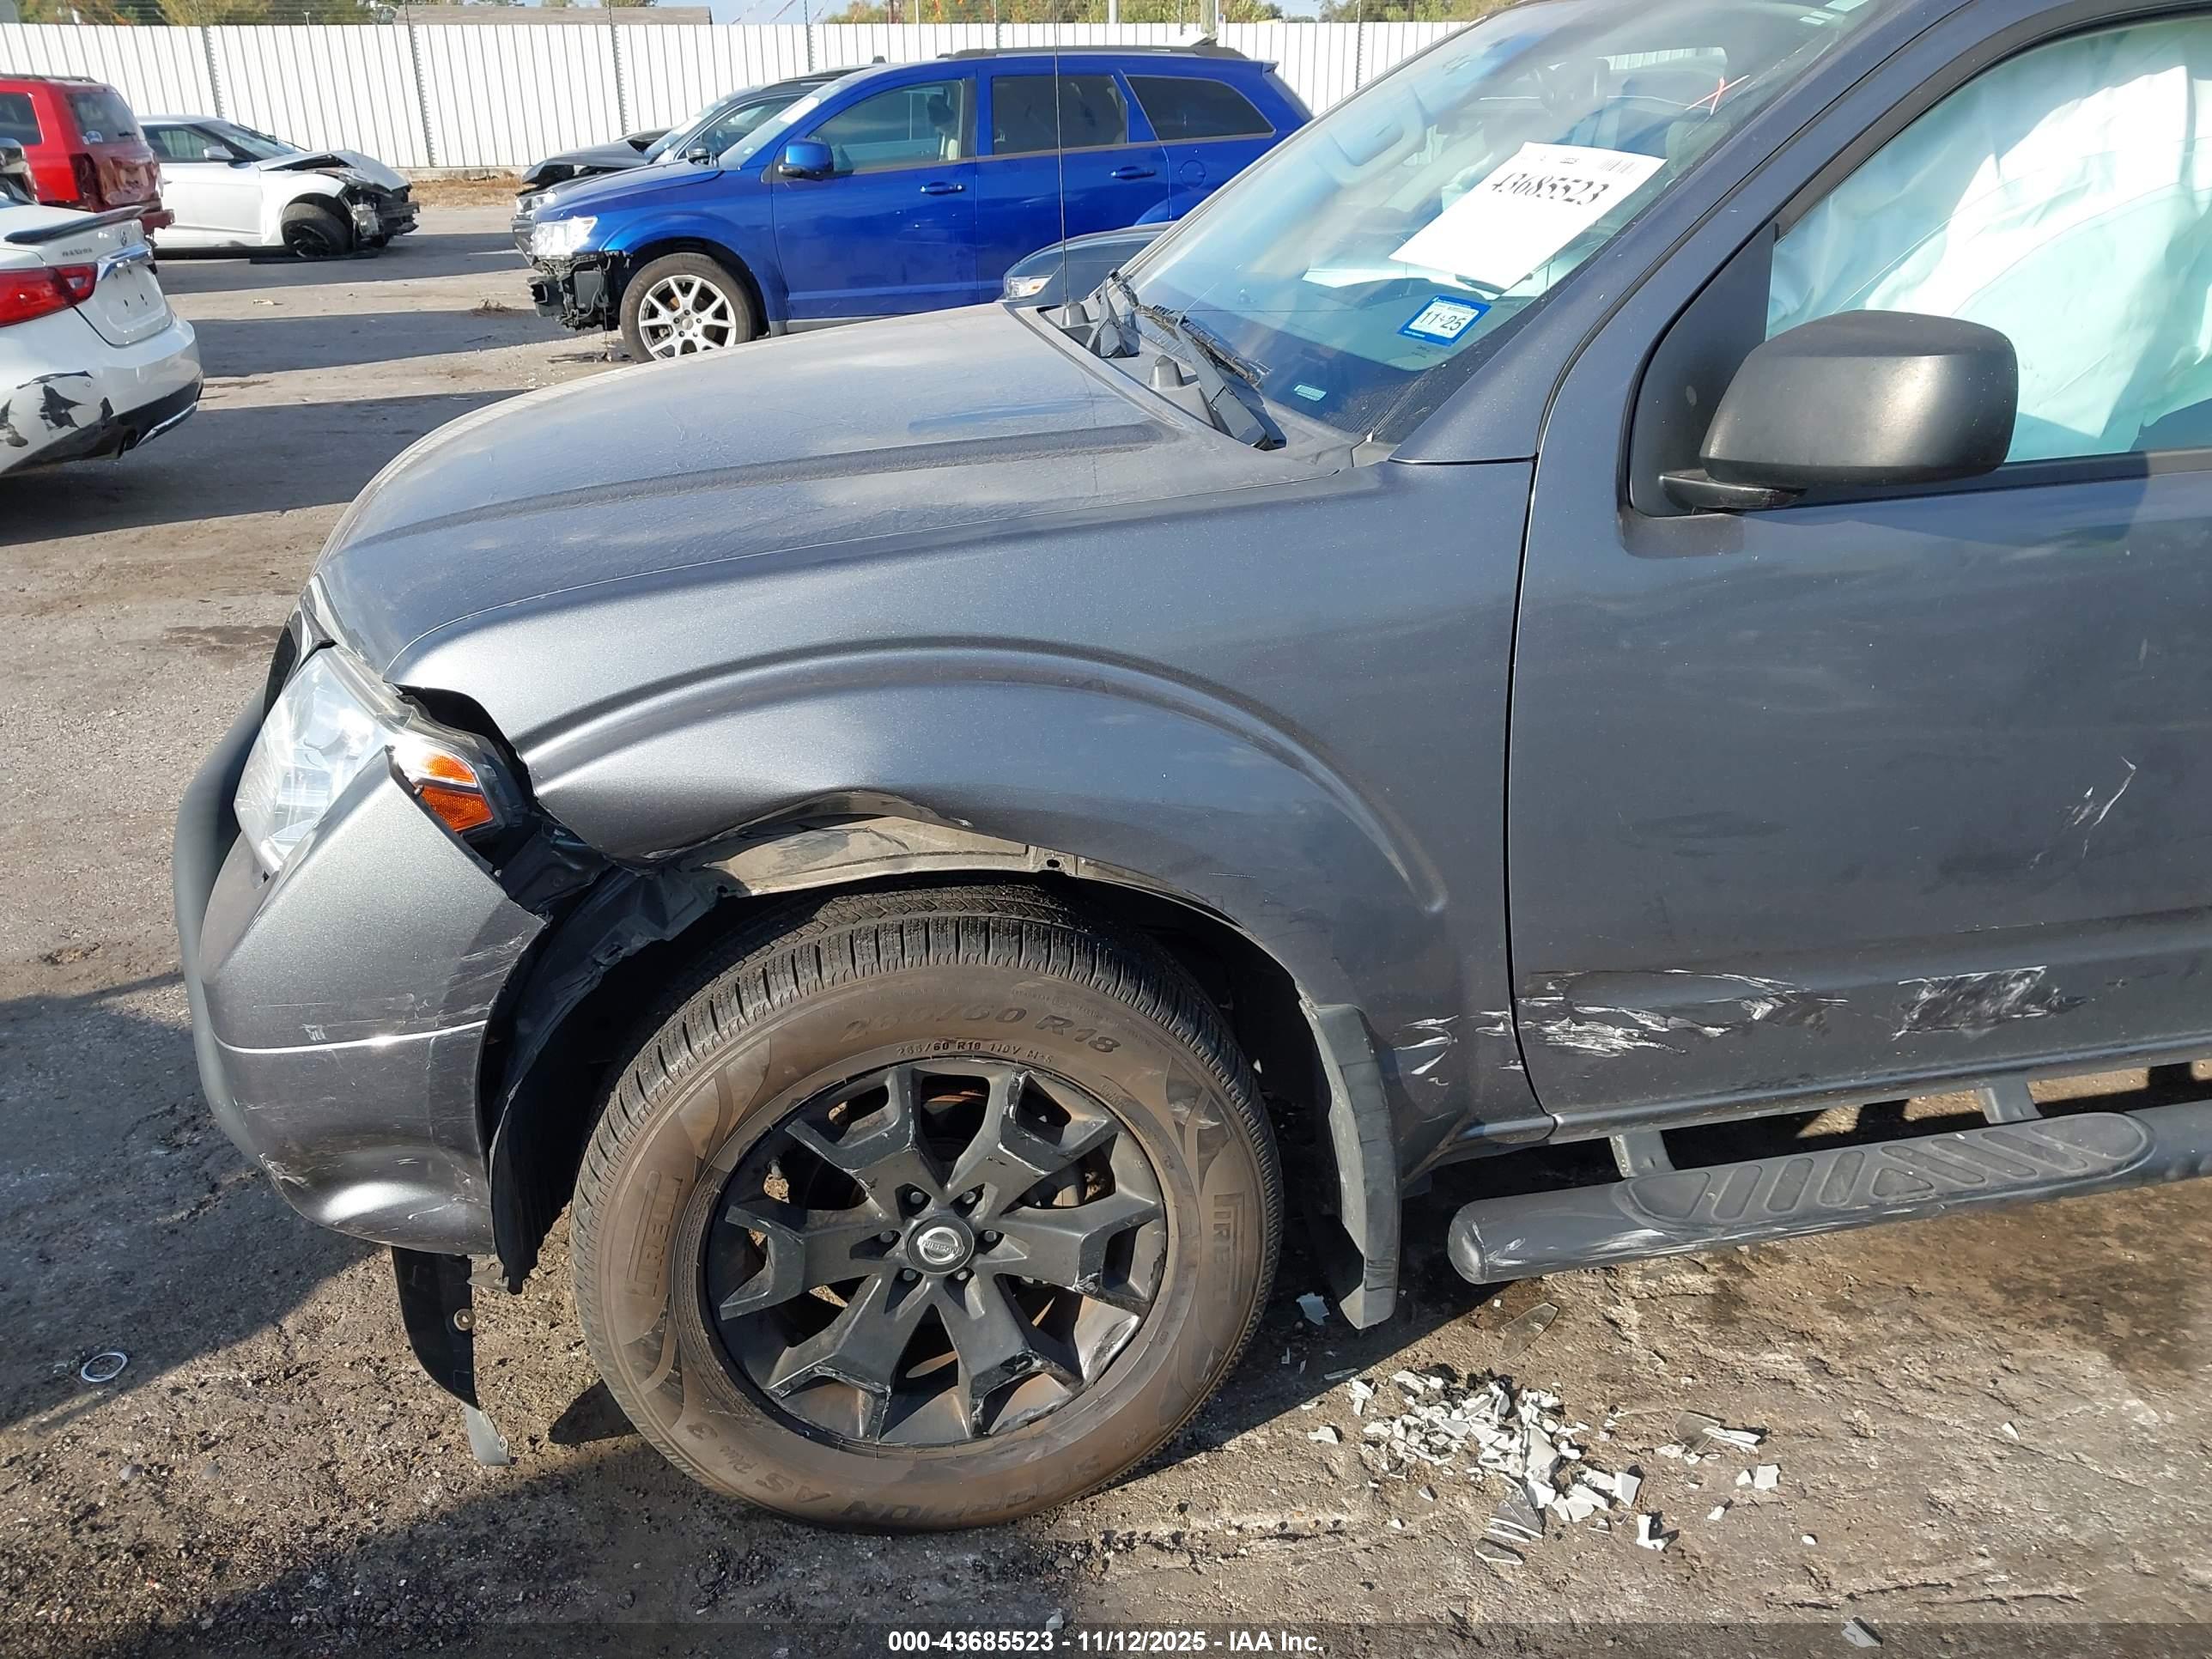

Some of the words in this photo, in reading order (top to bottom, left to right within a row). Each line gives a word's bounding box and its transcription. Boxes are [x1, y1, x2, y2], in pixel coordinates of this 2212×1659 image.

[1492, 173, 1610, 205] 43685523
[957, 1041, 982, 1051] R18
[1034, 1013, 1122, 1054] R18
[686, 1421, 719, 1444] 3
[754, 1470, 831, 1504] AS
